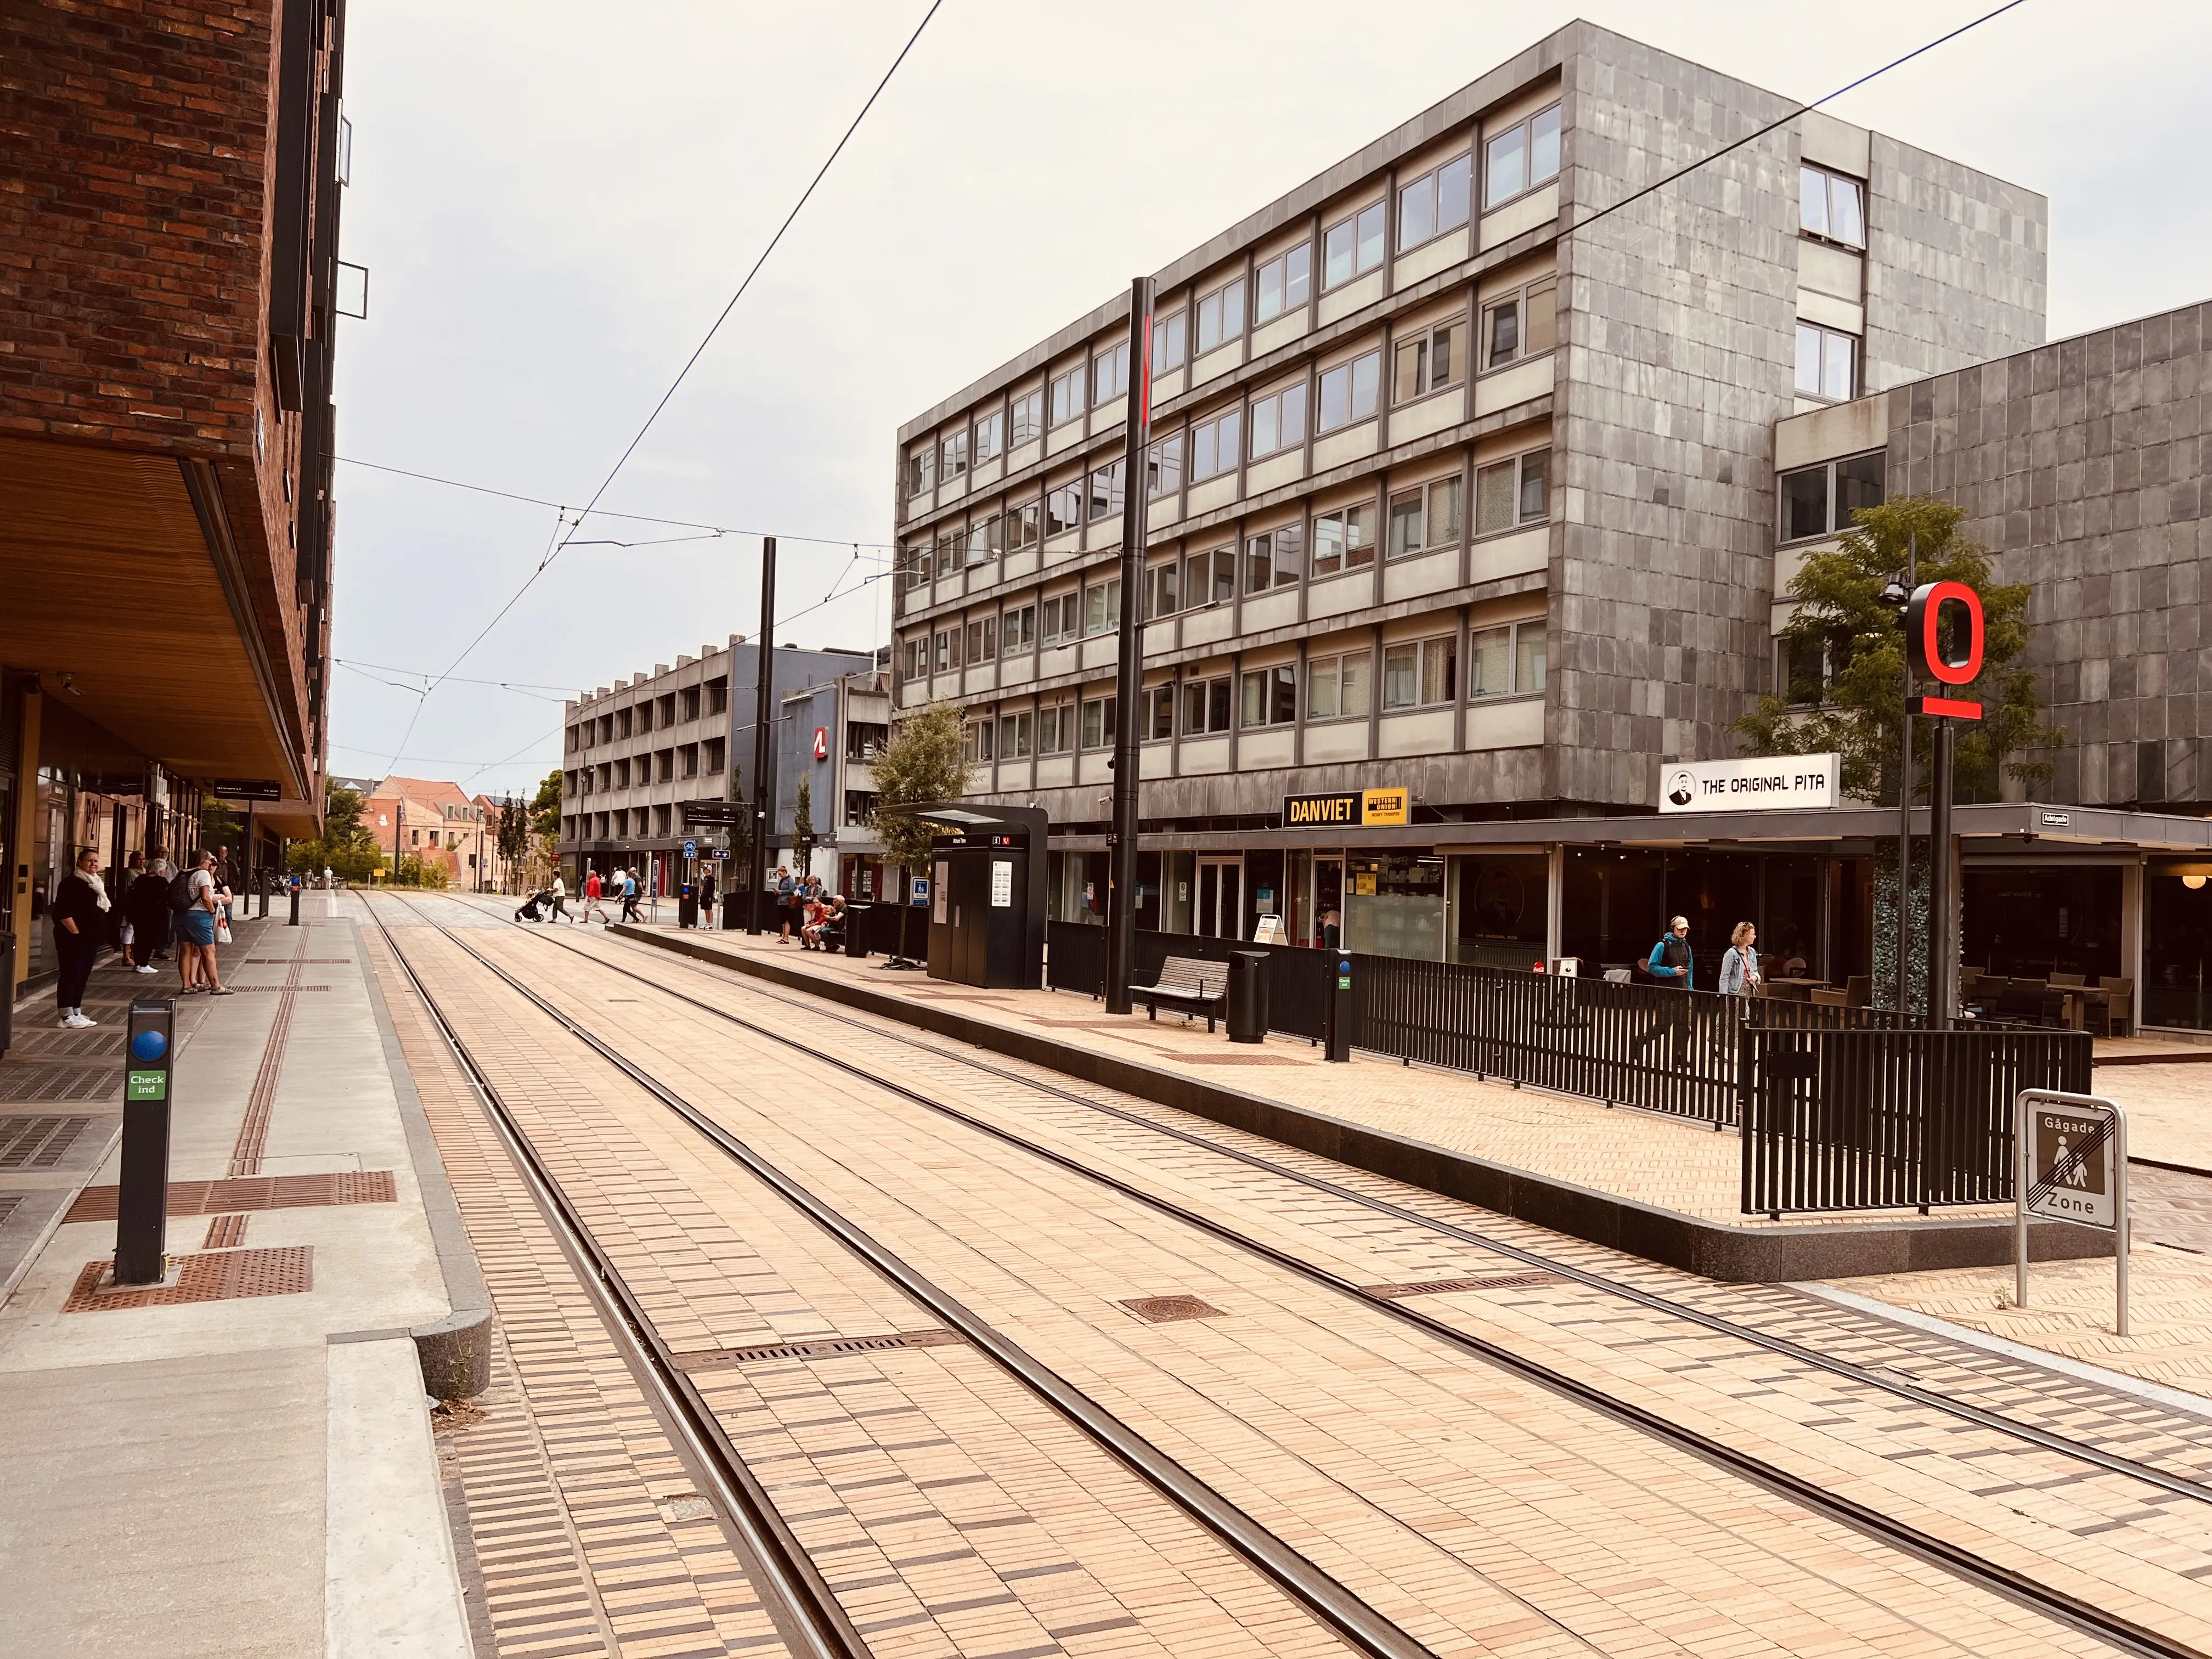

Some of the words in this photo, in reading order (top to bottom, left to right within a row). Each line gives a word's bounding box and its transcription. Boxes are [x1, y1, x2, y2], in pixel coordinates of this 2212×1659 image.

[1702, 779, 1726, 795] THE
[1731, 774, 1789, 794] ORIGINAL
[1795, 774, 1824, 791] PITA
[1291, 798, 1353, 822] DANVIET
[2044, 815, 2067, 823] Adelgade
[138, 1085, 155, 1093] ind
[2044, 1116, 2095, 1135] Gågade
[2047, 1191, 2094, 1214] Zone
